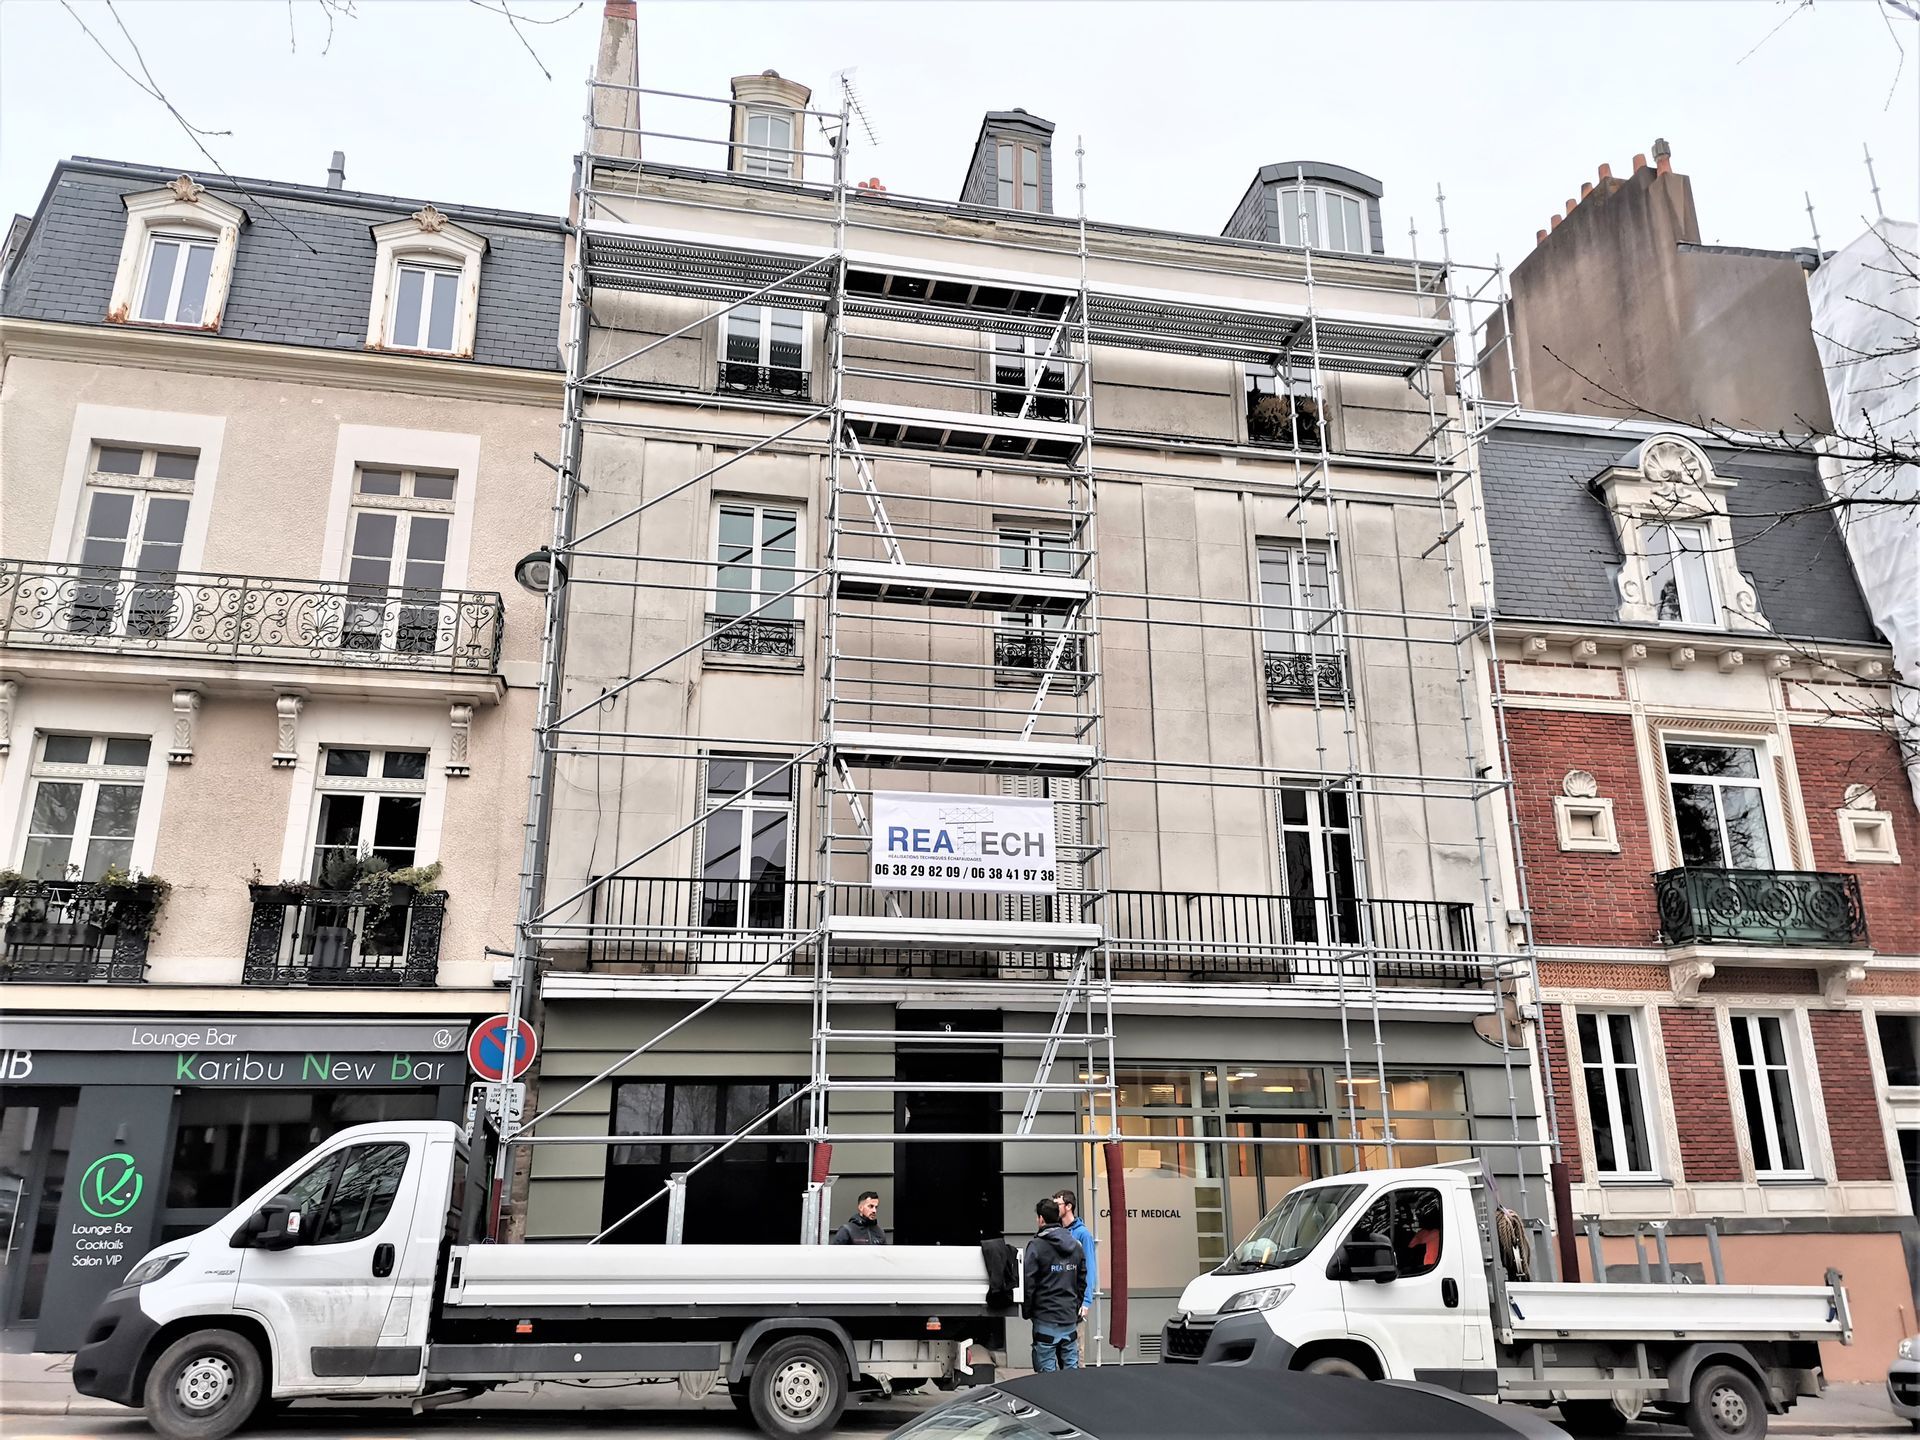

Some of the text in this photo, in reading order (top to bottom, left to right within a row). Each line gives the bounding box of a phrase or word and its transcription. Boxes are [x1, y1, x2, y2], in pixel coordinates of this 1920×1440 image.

[875, 863, 1055, 882] 06 38 29 82 09 / 06 38 41 97 38
[131, 1028, 237, 1048] Lounge Bar
[0, 1049, 33, 1079] B
[176, 1053, 445, 1081] Karibu New Bar
[1100, 1209, 1182, 1218] CAET MEDICAL
[71, 1222, 134, 1236] Lounge Bar
[75, 1238, 124, 1250] Cocktails
[71, 1254, 123, 1267] Salon VIP
